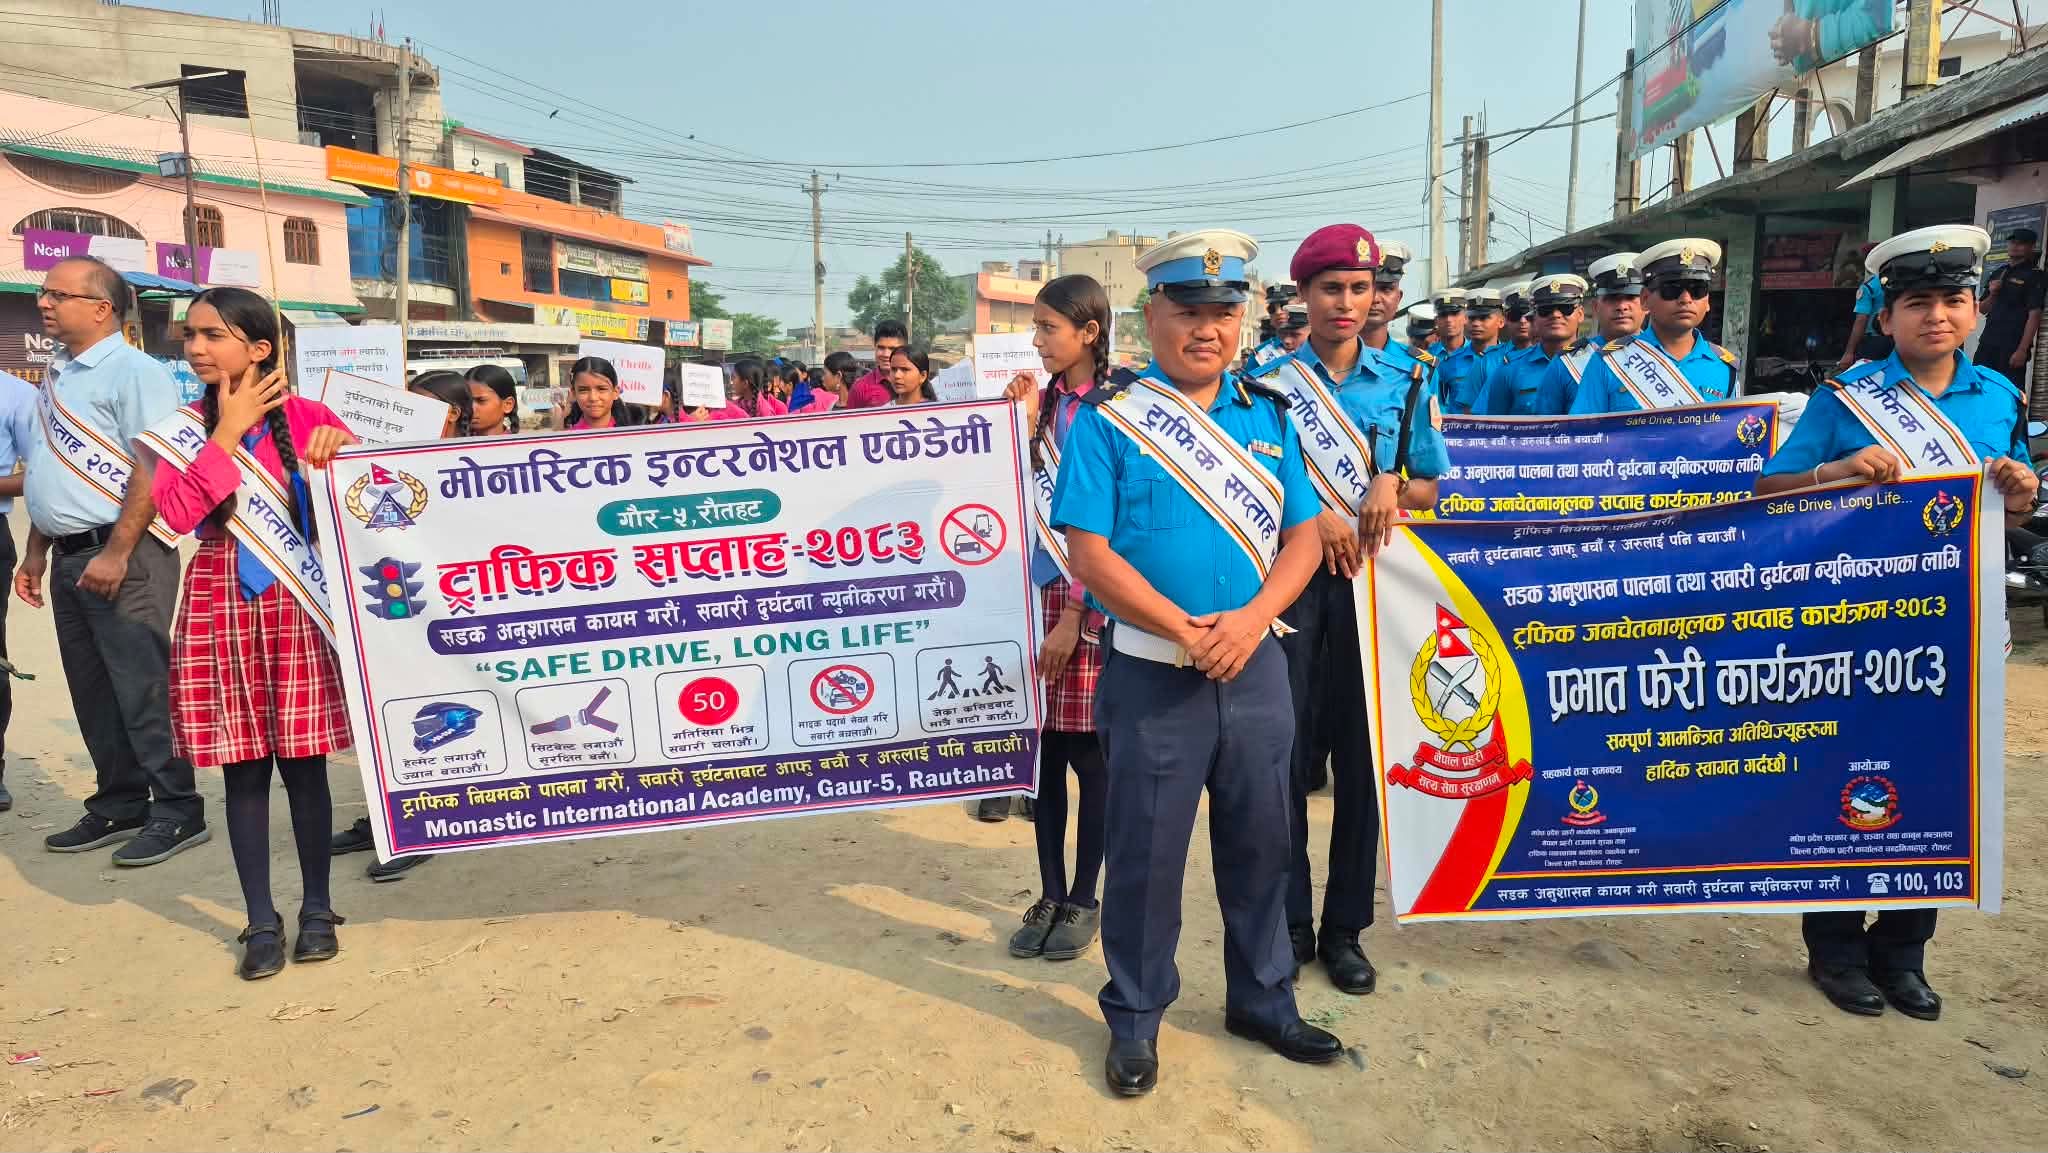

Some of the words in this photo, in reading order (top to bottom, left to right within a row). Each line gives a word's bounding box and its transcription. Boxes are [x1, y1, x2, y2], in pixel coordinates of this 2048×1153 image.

[34, 242, 71, 258] Ncell
[1622, 350, 1673, 398] ट्राफिक
[344, 390, 395, 413] दुर्घटनाको
[392, 401, 414, 417] पिडा
[1284, 386, 1338, 451] ट्राफिक
[1626, 416, 1647, 426] Safe
[1678, 414, 1701, 426] Long
[1855, 376, 1926, 435] ट्राफिक
[438, 449, 632, 499] मोनास्टिक
[645, 432, 847, 488] इन्टरनेशल
[860, 413, 993, 465] एकेडेमी
[1139, 403, 1225, 474] ट्राफिक
[1224, 472, 1278, 543] सप्ताह
[1464, 463, 1514, 484] अनुशासन
[1519, 463, 1553, 479] पालना
[1557, 463, 1579, 478] तथा
[1581, 458, 1614, 478] सवारी
[1617, 457, 1656, 481] दुर्घटना
[1659, 455, 1734, 480] न्यूनिकरणका
[1737, 453, 1764, 473] लागि
[1488, 491, 1594, 516] जनचेतनामूलक
[1598, 494, 1646, 512] सप्ताह
[1766, 500, 1796, 515] Safe
[1799, 497, 1837, 512] Drive,
[1840, 492, 1873, 510] Long
[1876, 490, 1913, 505] Life...
[247, 491, 303, 554] सप्ताह
[1447, 548, 1479, 565] सवारी
[1484, 544, 1543, 567] दुर्घटनाबाट
[1549, 541, 1579, 560] आफू
[1608, 540, 1615, 552] र
[1620, 532, 1664, 551] अरुलाई
[1669, 531, 1692, 546] पनि
[437, 544, 620, 615] ट्राफिक
[633, 520, 925, 588] सप्ताह-२०८३
[1502, 585, 1543, 607] सडक
[1548, 578, 1618, 607] अनुशासन
[1623, 573, 1672, 596] पालना
[1676, 570, 1706, 593] तथा
[1710, 561, 1755, 588] सवारी
[1760, 561, 1810, 591] दुर्घटना
[1815, 552, 1917, 585] न्यूनिकरणका
[1921, 543, 1962, 572] लागि
[439, 625, 487, 648] सडक
[496, 616, 576, 645] अनुशासन
[585, 609, 638, 631] कायम
[645, 599, 688, 628] गरौं,
[696, 594, 747, 620] सवारी
[757, 589, 813, 621] दुर्घटना
[820, 583, 905, 614] न्युनीकरण
[1582, 609, 1727, 643] जनचेतनामूलक
[1732, 606, 1794, 632] सप्ताह
[1800, 595, 1947, 626] कार्यक्रम-२०८३
[476, 651, 592, 683] “SAFE
[601, 639, 722, 672] DRIVE,
[733, 629, 830, 658] LONG
[841, 619, 930, 648] LIFE”
[1546, 665, 1628, 722] प्रभात
[1637, 645, 1706, 711] फेरी
[1716, 643, 1948, 706] कार्यक्रम-२०८३
[693, 690, 725, 712] 50
[671, 726, 723, 741] गतिसिमा
[731, 723, 755, 736] भित्र
[1605, 727, 1652, 753] सम्पूर्ण
[1656, 723, 1724, 748] आमन्त्रित
[1728, 719, 1839, 744] अतिथिज्यूहरुमा
[401, 770, 434, 782] ज्यान
[1433, 750, 1459, 767] नेपाल
[1462, 749, 1484, 768] प्रहरी
[1541, 766, 1572, 780] सहकार्य
[1574, 765, 1589, 777] तथा
[1646, 758, 1691, 781] हार्दिक
[1695, 757, 1739, 777] स्वागत
[1847, 757, 1891, 772] आयोजक
[402, 791, 460, 820] ट्राफिक
[466, 782, 531, 806] नियमको
[538, 778, 588, 799] पालना
[638, 767, 684, 790] सवारी
[690, 763, 768, 788] दुर्घटनाबाट
[858, 752, 870, 768] र
[876, 740, 930, 764] अरुलाई
[936, 736, 965, 758] पनि
[425, 810, 537, 839] Monastic
[543, 791, 696, 827] International
[701, 783, 811, 810] Academy,
[817, 772, 903, 799] Gaur-5,
[908, 761, 1015, 789] Rautahat
[1497, 888, 1529, 902] सडक
[1534, 886, 1592, 903] अनुशासन
[1597, 884, 1631, 897] कायम
[1636, 881, 1658, 897] गरी
[1663, 880, 1697, 897] सवारी
[1702, 878, 1744, 899] दुर्घटना
[1750, 876, 1814, 898] न्यूनिकरण
[1818, 875, 1841, 893] गरौं
[1894, 872, 1929, 894] 100,
[1933, 871, 1964, 891] 103
